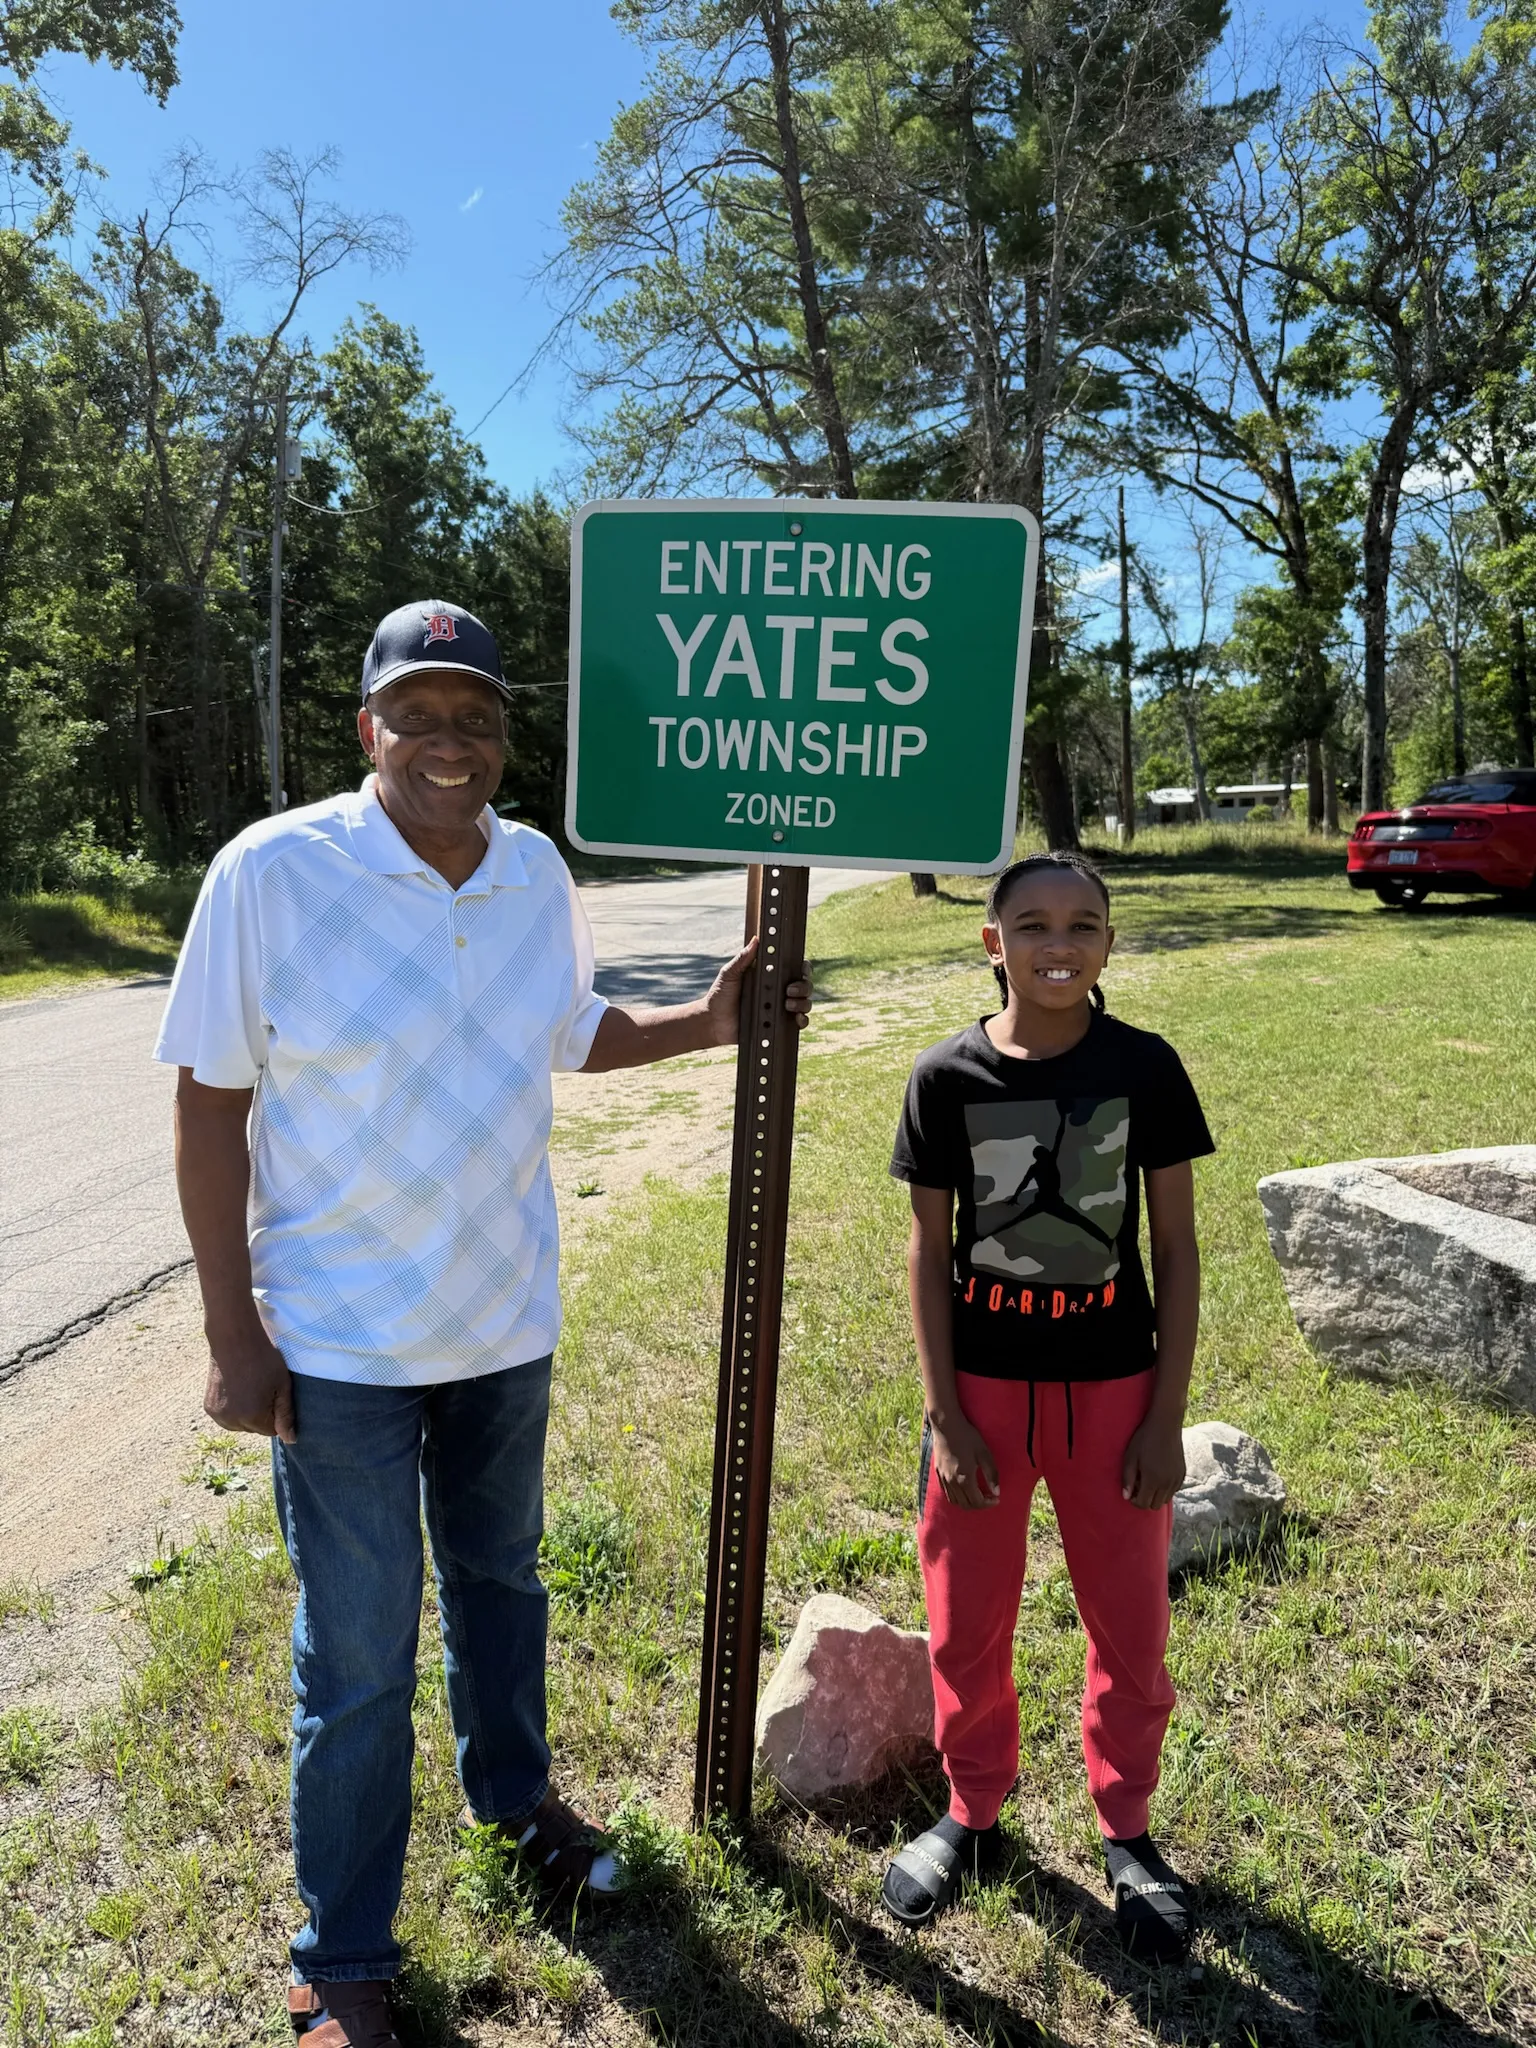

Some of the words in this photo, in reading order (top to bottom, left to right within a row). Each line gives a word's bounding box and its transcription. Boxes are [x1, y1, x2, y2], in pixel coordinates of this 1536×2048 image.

[659, 540, 932, 600] ENTERING
[655, 613, 930, 706] YATES
[648, 716, 928, 778] TOWNSHIP
[725, 792, 836, 828] ZONED
[1122, 1881, 1184, 1901] BALENCIAGA
